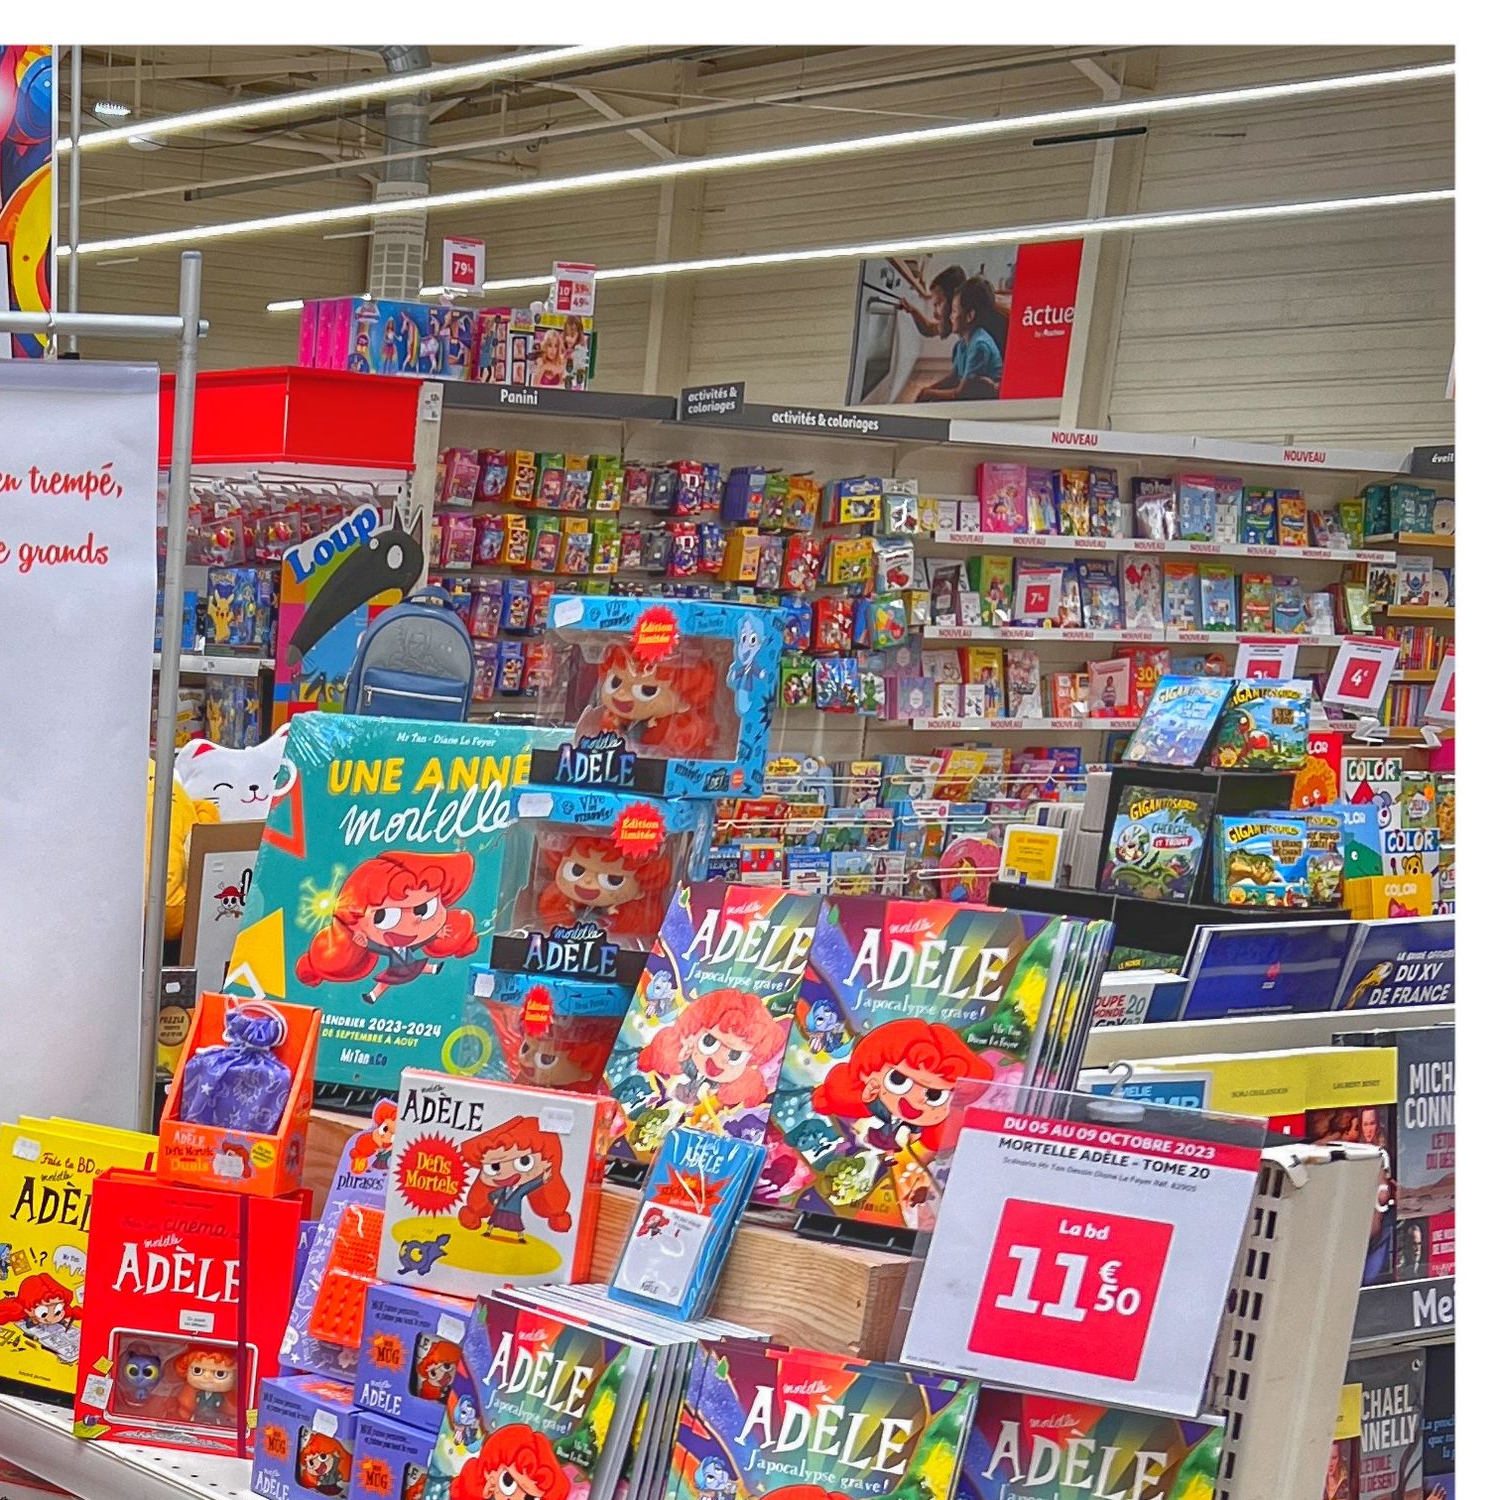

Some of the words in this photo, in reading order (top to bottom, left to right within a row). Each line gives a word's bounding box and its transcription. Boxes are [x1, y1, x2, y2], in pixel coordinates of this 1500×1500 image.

[500, 388, 538, 405] Panini
[688, 387, 728, 402] activités
[729, 387, 737, 398] &
[688, 400, 735, 415] coloriages
[772, 411, 816, 427] activités
[818, 414, 827, 427] &
[827, 415, 879, 433] coloriages
[1051, 432, 1098, 446] NOUVEAU
[1284, 450, 1326, 463] NOUVEAU
[29, 464, 123, 500] trempé,
[18, 534, 110, 573] grands
[284, 504, 380, 586] Loup
[328, 757, 405, 796] UNE
[554, 742, 635, 788] ADÈLE
[1348, 759, 1396, 782] COLOR
[339, 781, 520, 847] mortelle
[1151, 822, 1189, 836] CHERCHE
[1387, 830, 1437, 852] COLOR
[1384, 882, 1417, 898] COLOR
[681, 907, 818, 977] ADÈLE
[522, 930, 619, 978] ADÈLE
[844, 925, 1011, 1003] ADÈLE
[1395, 965, 1418, 982] DU
[1420, 964, 1439, 982] XV
[1369, 988, 1391, 1006] DE
[1393, 983, 1451, 1004] FRANCE
[368, 1017, 442, 1038] 2023-2024
[400, 1089, 485, 1134] ADÈLE
[1003, 1116, 1027, 1132] DU
[1029, 1119, 1050, 1134] 05
[1052, 1123, 1077, 1138] AU
[1078, 1127, 1097, 1143] 09
[1099, 1130, 1172, 1153] OCTOBRE
[1174, 1141, 1215, 1160] 2023
[416, 1150, 452, 1172] Défis
[998, 1137, 1076, 1160] MORTELLE
[1079, 1144, 1129, 1168] ADÈLE
[1143, 1159, 1187, 1178] TOME
[1189, 1166, 1210, 1180] 20
[336, 1172, 385, 1191] phrases
[404, 1168, 459, 1196] Mortels
[1058, 1218, 1081, 1236] La
[1084, 1223, 1110, 1241] bd
[111, 1242, 242, 1304] ADÈLE
[375, 1346, 401, 1367] MUG
[482, 1331, 594, 1418] ADÈLE
[360, 1385, 402, 1415] ADÈLE
[733, 1384, 915, 1476] ADÈLE
[267, 1436, 287, 1456] MUG
[362, 1469, 388, 1490] MUG
